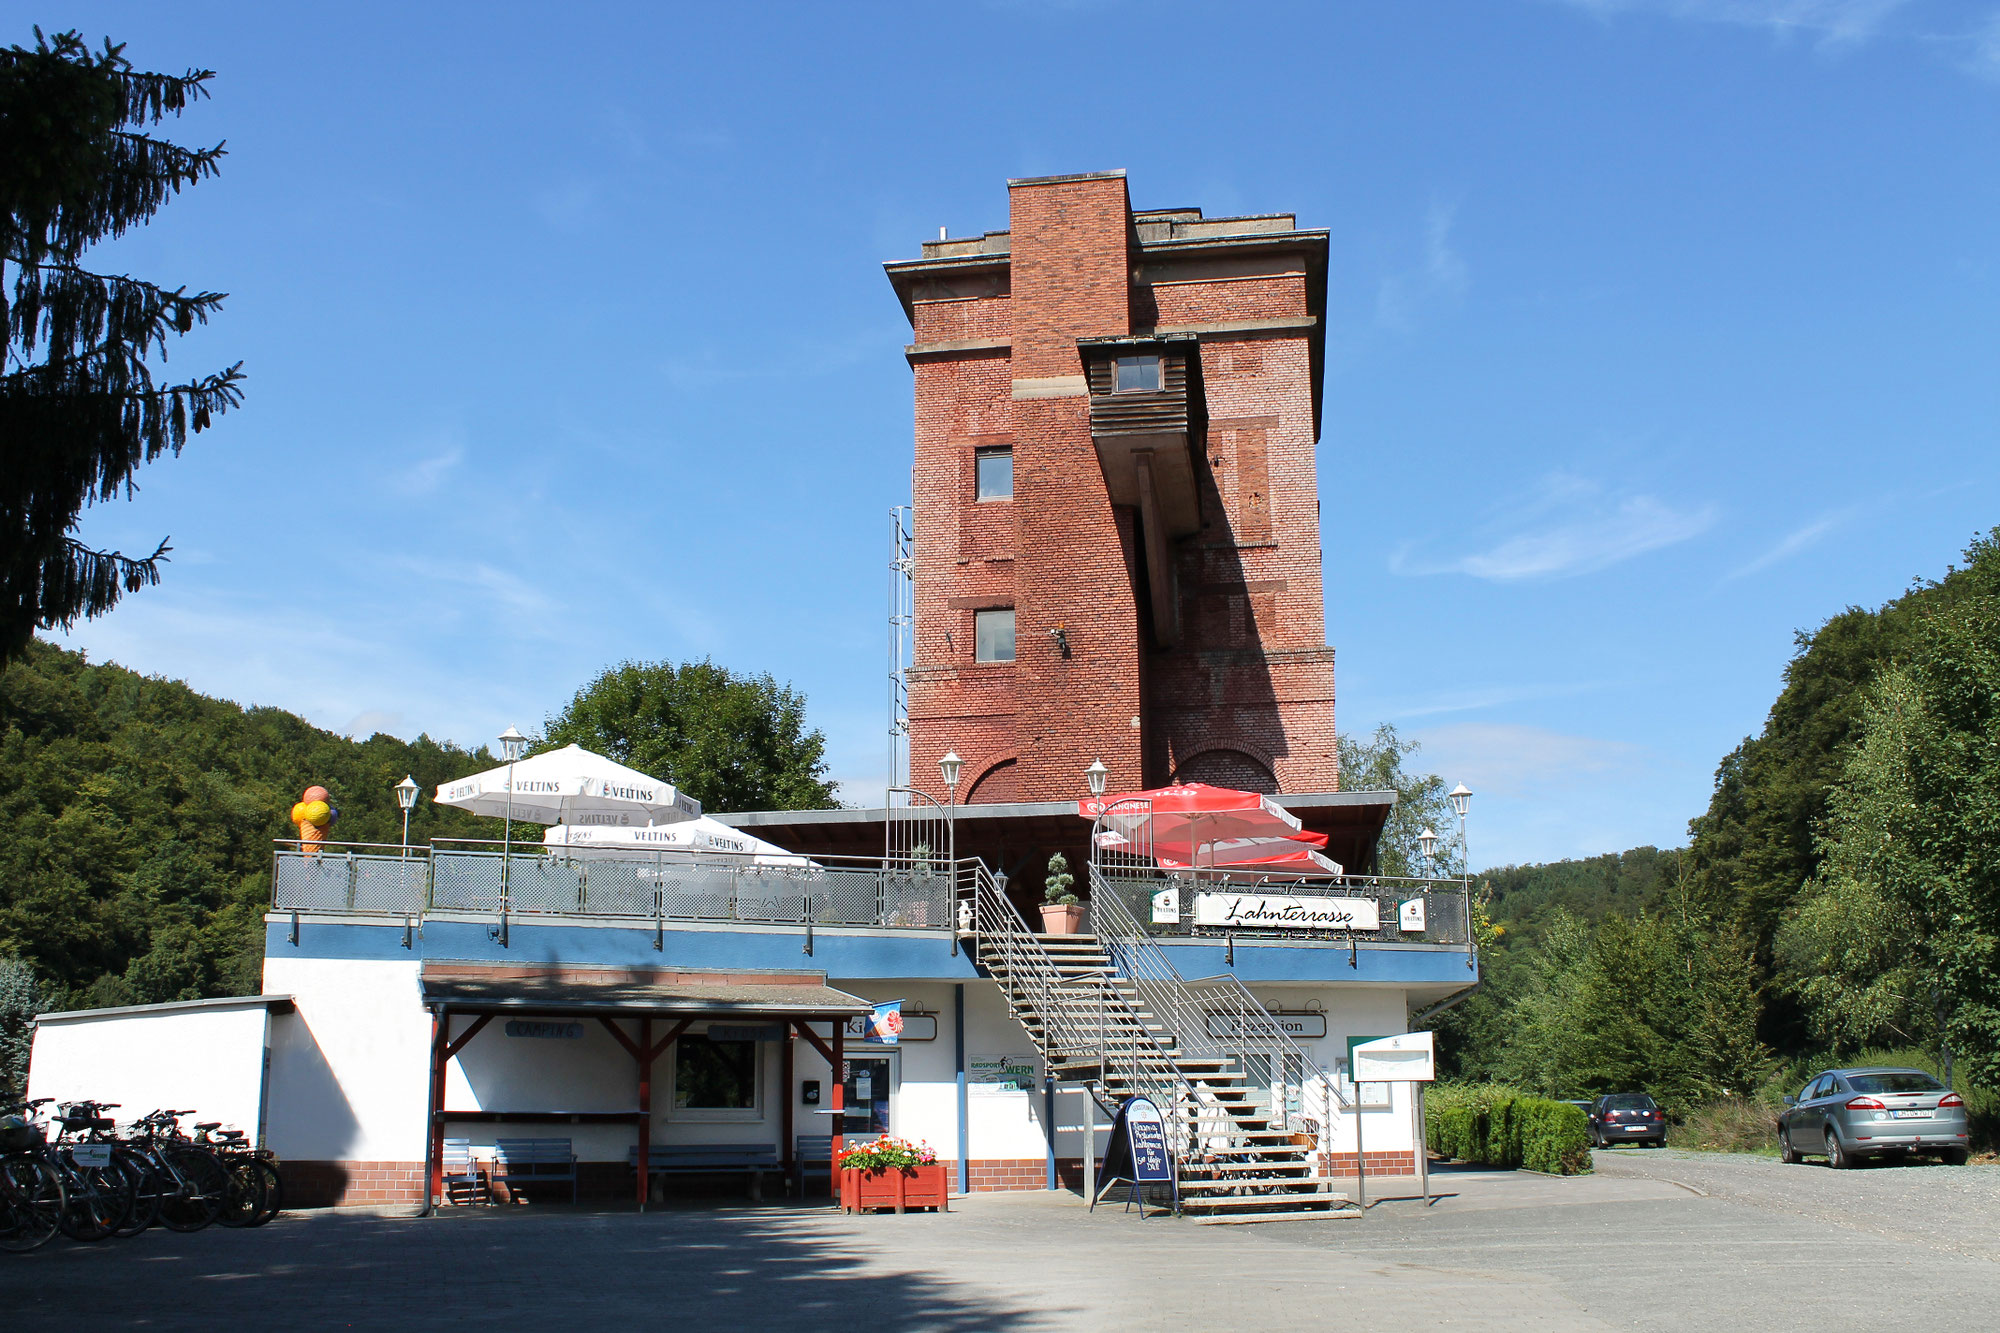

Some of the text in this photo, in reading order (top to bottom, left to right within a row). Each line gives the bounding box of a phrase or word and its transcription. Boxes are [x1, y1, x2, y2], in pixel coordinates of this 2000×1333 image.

[515, 781, 560, 793] VELTINS
[612, 786, 653, 801] VELTINS
[634, 831, 677, 842] VELTINS
[714, 837, 744, 852] VELTINS
[1225, 897, 1354, 922] Lahnterrasse
[516, 1023, 574, 1037] CAMPING
[1231, 1020, 1303, 1033] Rezepion
[1005, 1065, 1034, 1075] WERN
